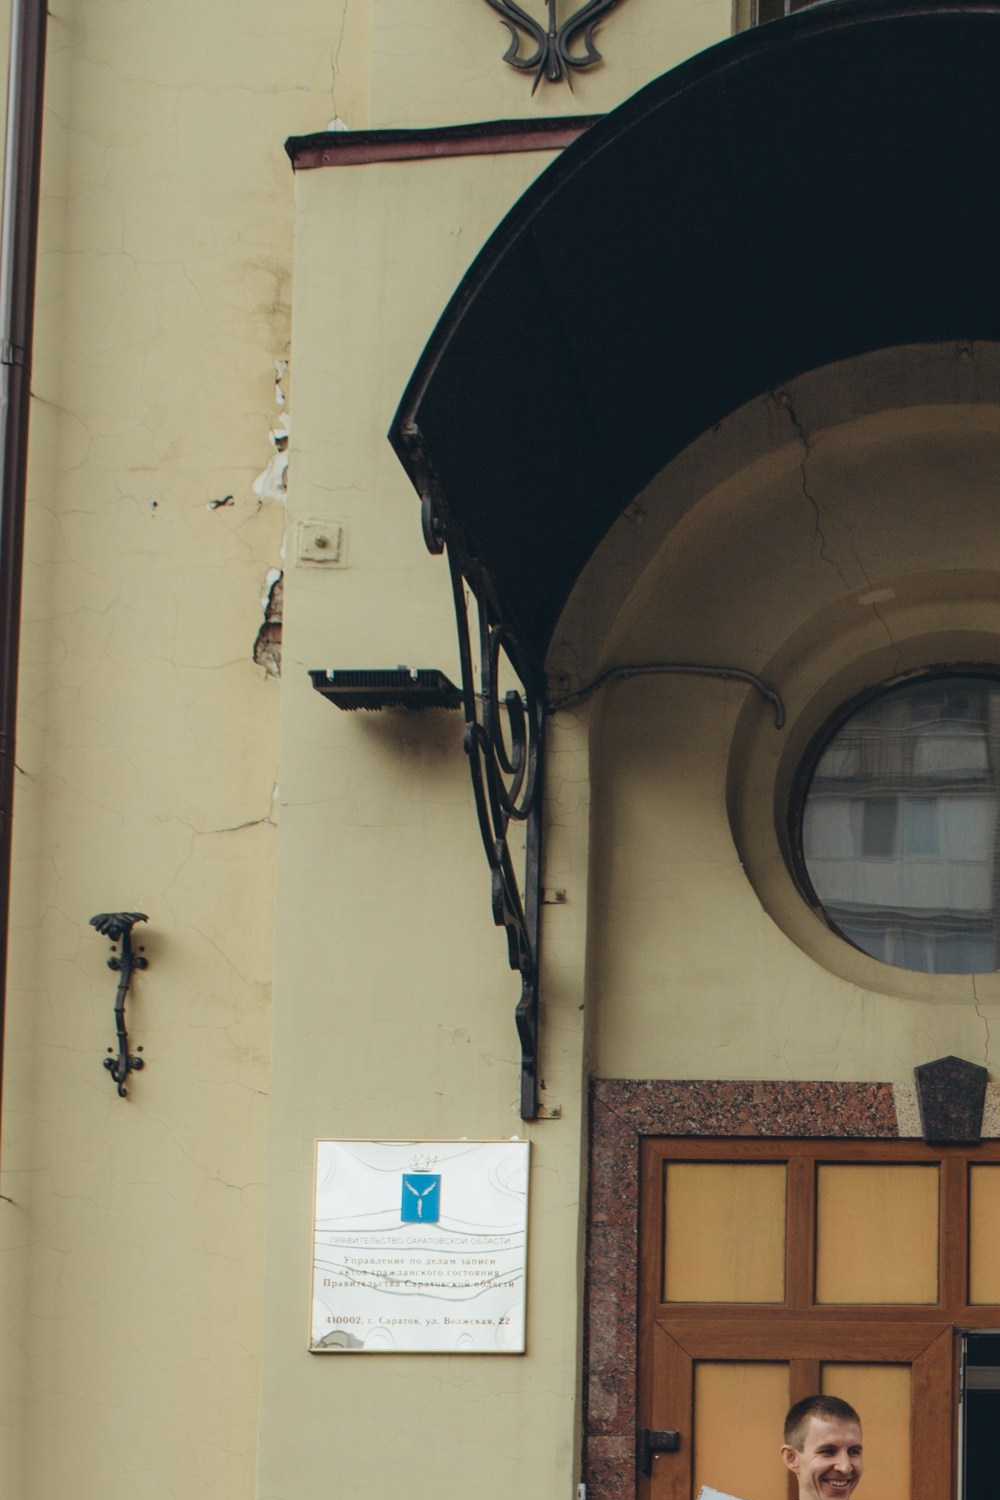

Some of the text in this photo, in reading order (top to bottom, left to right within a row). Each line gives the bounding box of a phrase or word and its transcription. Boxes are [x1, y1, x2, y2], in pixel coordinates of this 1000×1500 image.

[329, 1236, 511, 1245] ПРАВИТЕЛЬСТВО САРАТОВСКОЙ ОБЛАСТИ
[343, 1256, 406, 1266] Управление
[425, 1258, 456, 1266] делам
[370, 1269, 443, 1278] гражданского
[323, 1278, 515, 1289] Правительства Саратовской области
[378, 1316, 422, 1326] Саратов,
[425, 1318, 440, 1327] ул.
[444, 1316, 496, 1326] Волжская,
[498, 1316, 511, 1325] 22
